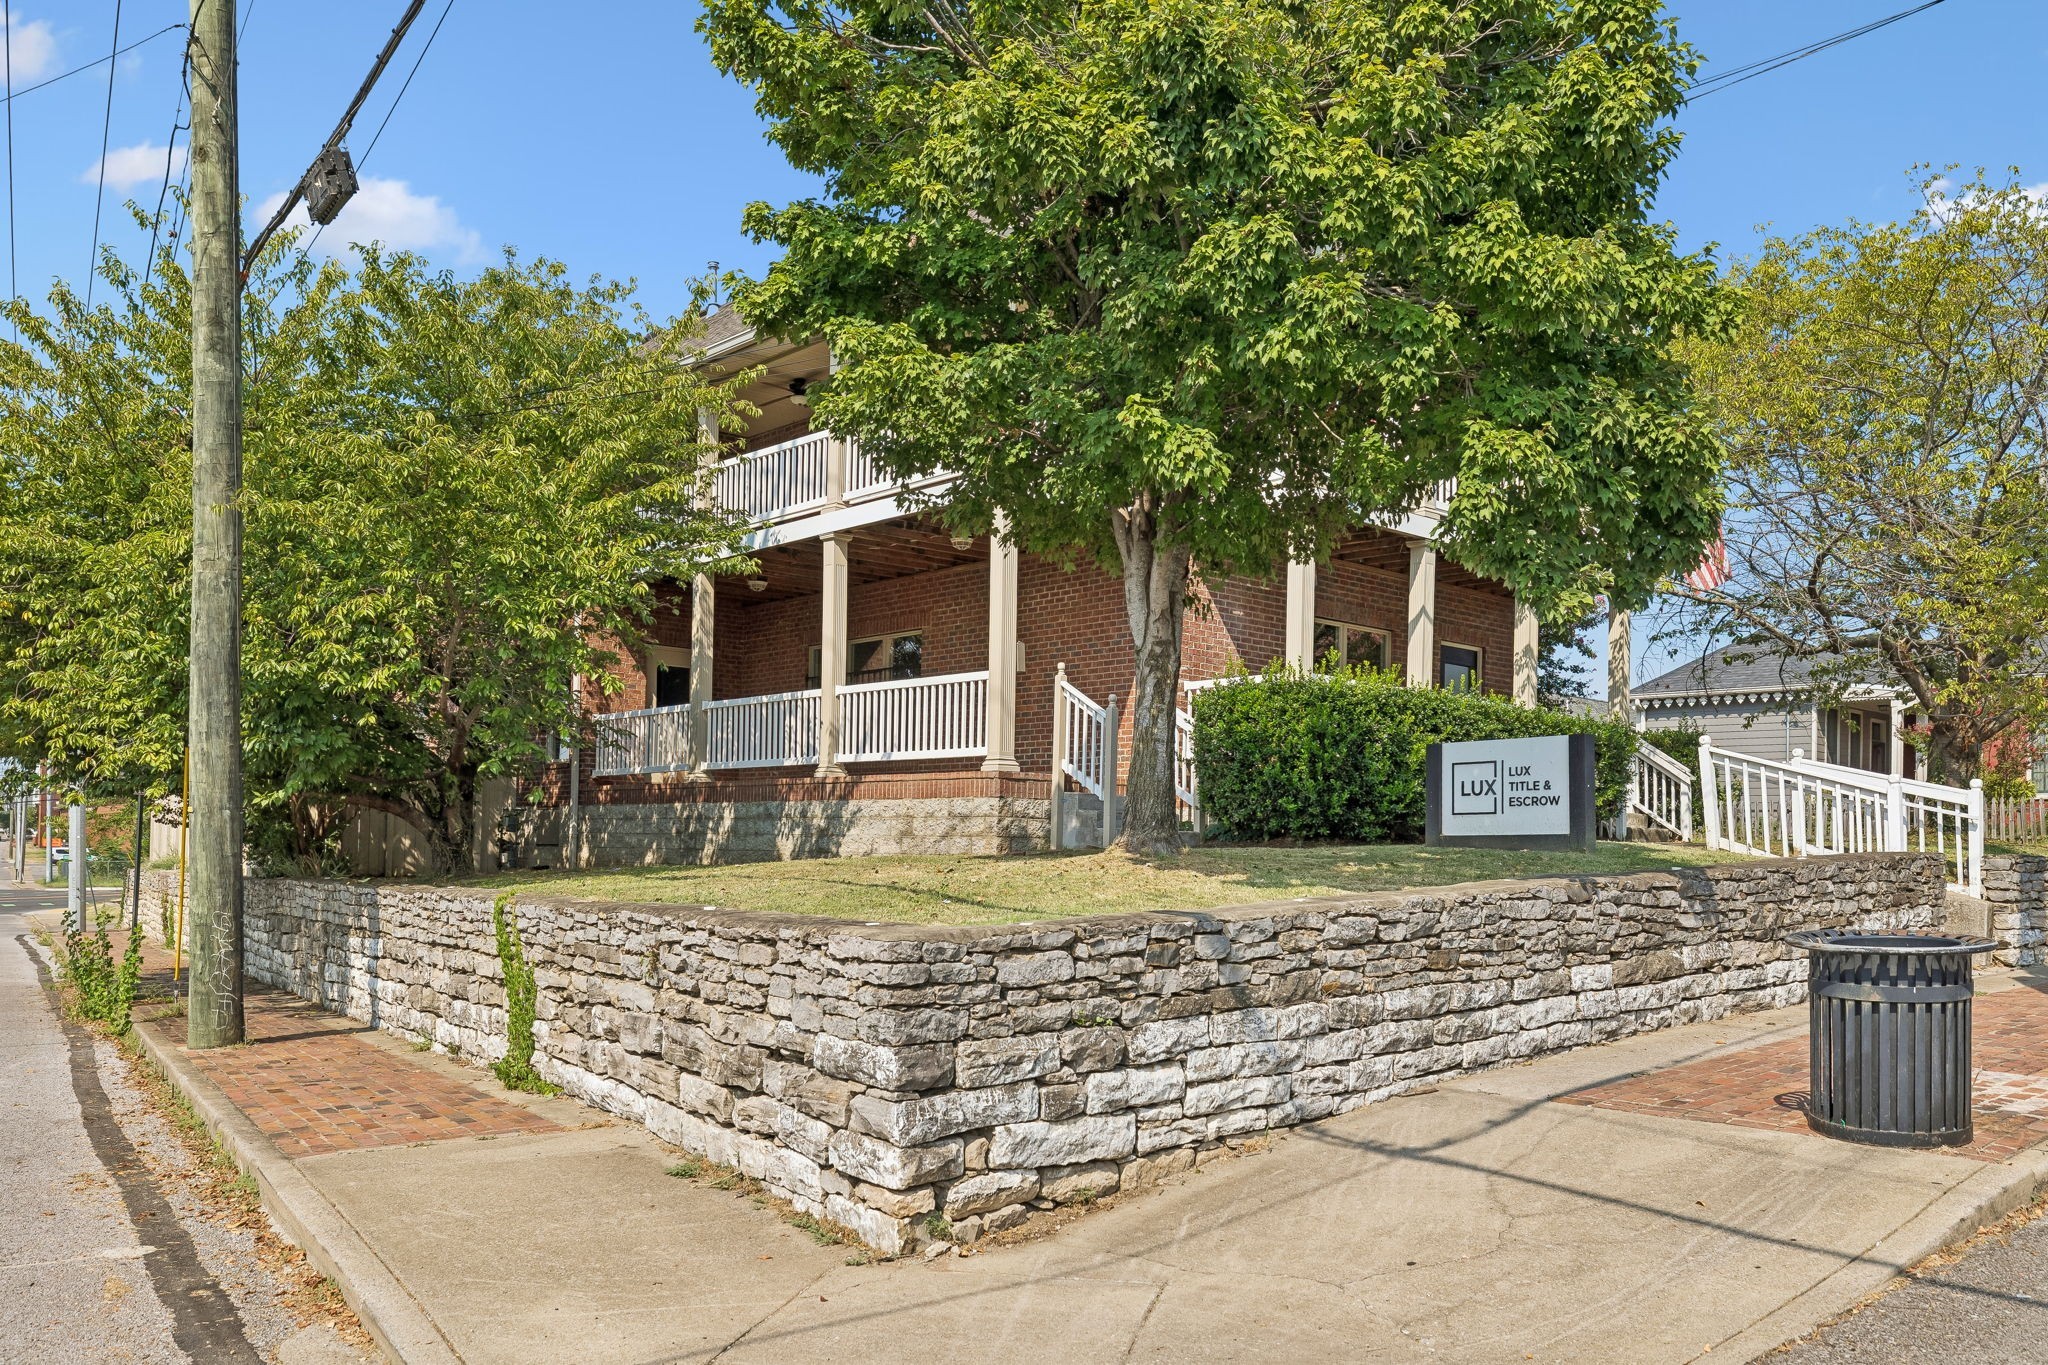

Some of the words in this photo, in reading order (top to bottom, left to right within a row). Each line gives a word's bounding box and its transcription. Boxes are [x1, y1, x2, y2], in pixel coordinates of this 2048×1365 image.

[1509, 765, 1531, 777] LUX
[1461, 779, 1497, 797] LUX
[1509, 781, 1540, 792] TITLE
[1543, 780, 1552, 790] &
[1509, 795, 1561, 807] ESCROW
